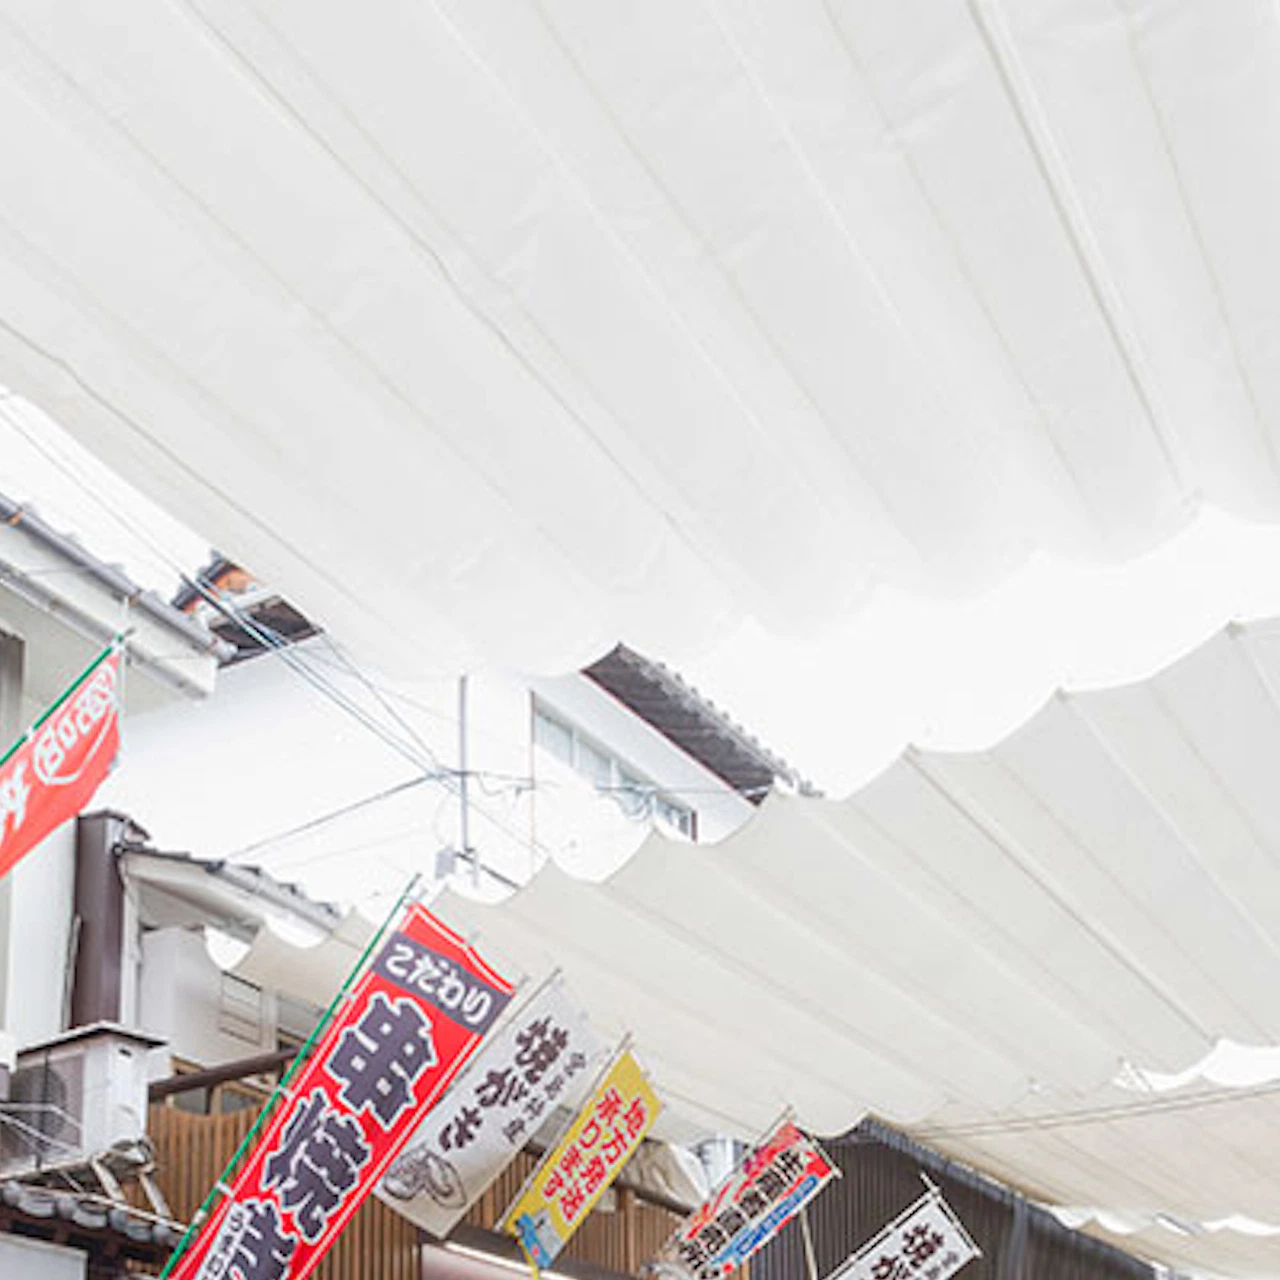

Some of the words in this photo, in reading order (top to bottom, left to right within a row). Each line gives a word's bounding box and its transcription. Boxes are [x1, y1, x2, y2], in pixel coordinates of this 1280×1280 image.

[385, 941, 493, 1024] こだわり
[437, 1016, 570, 1151] 焼がき
[541, 1087, 618, 1204] 承ります
[559, 1095, 653, 1222] 地方発送
